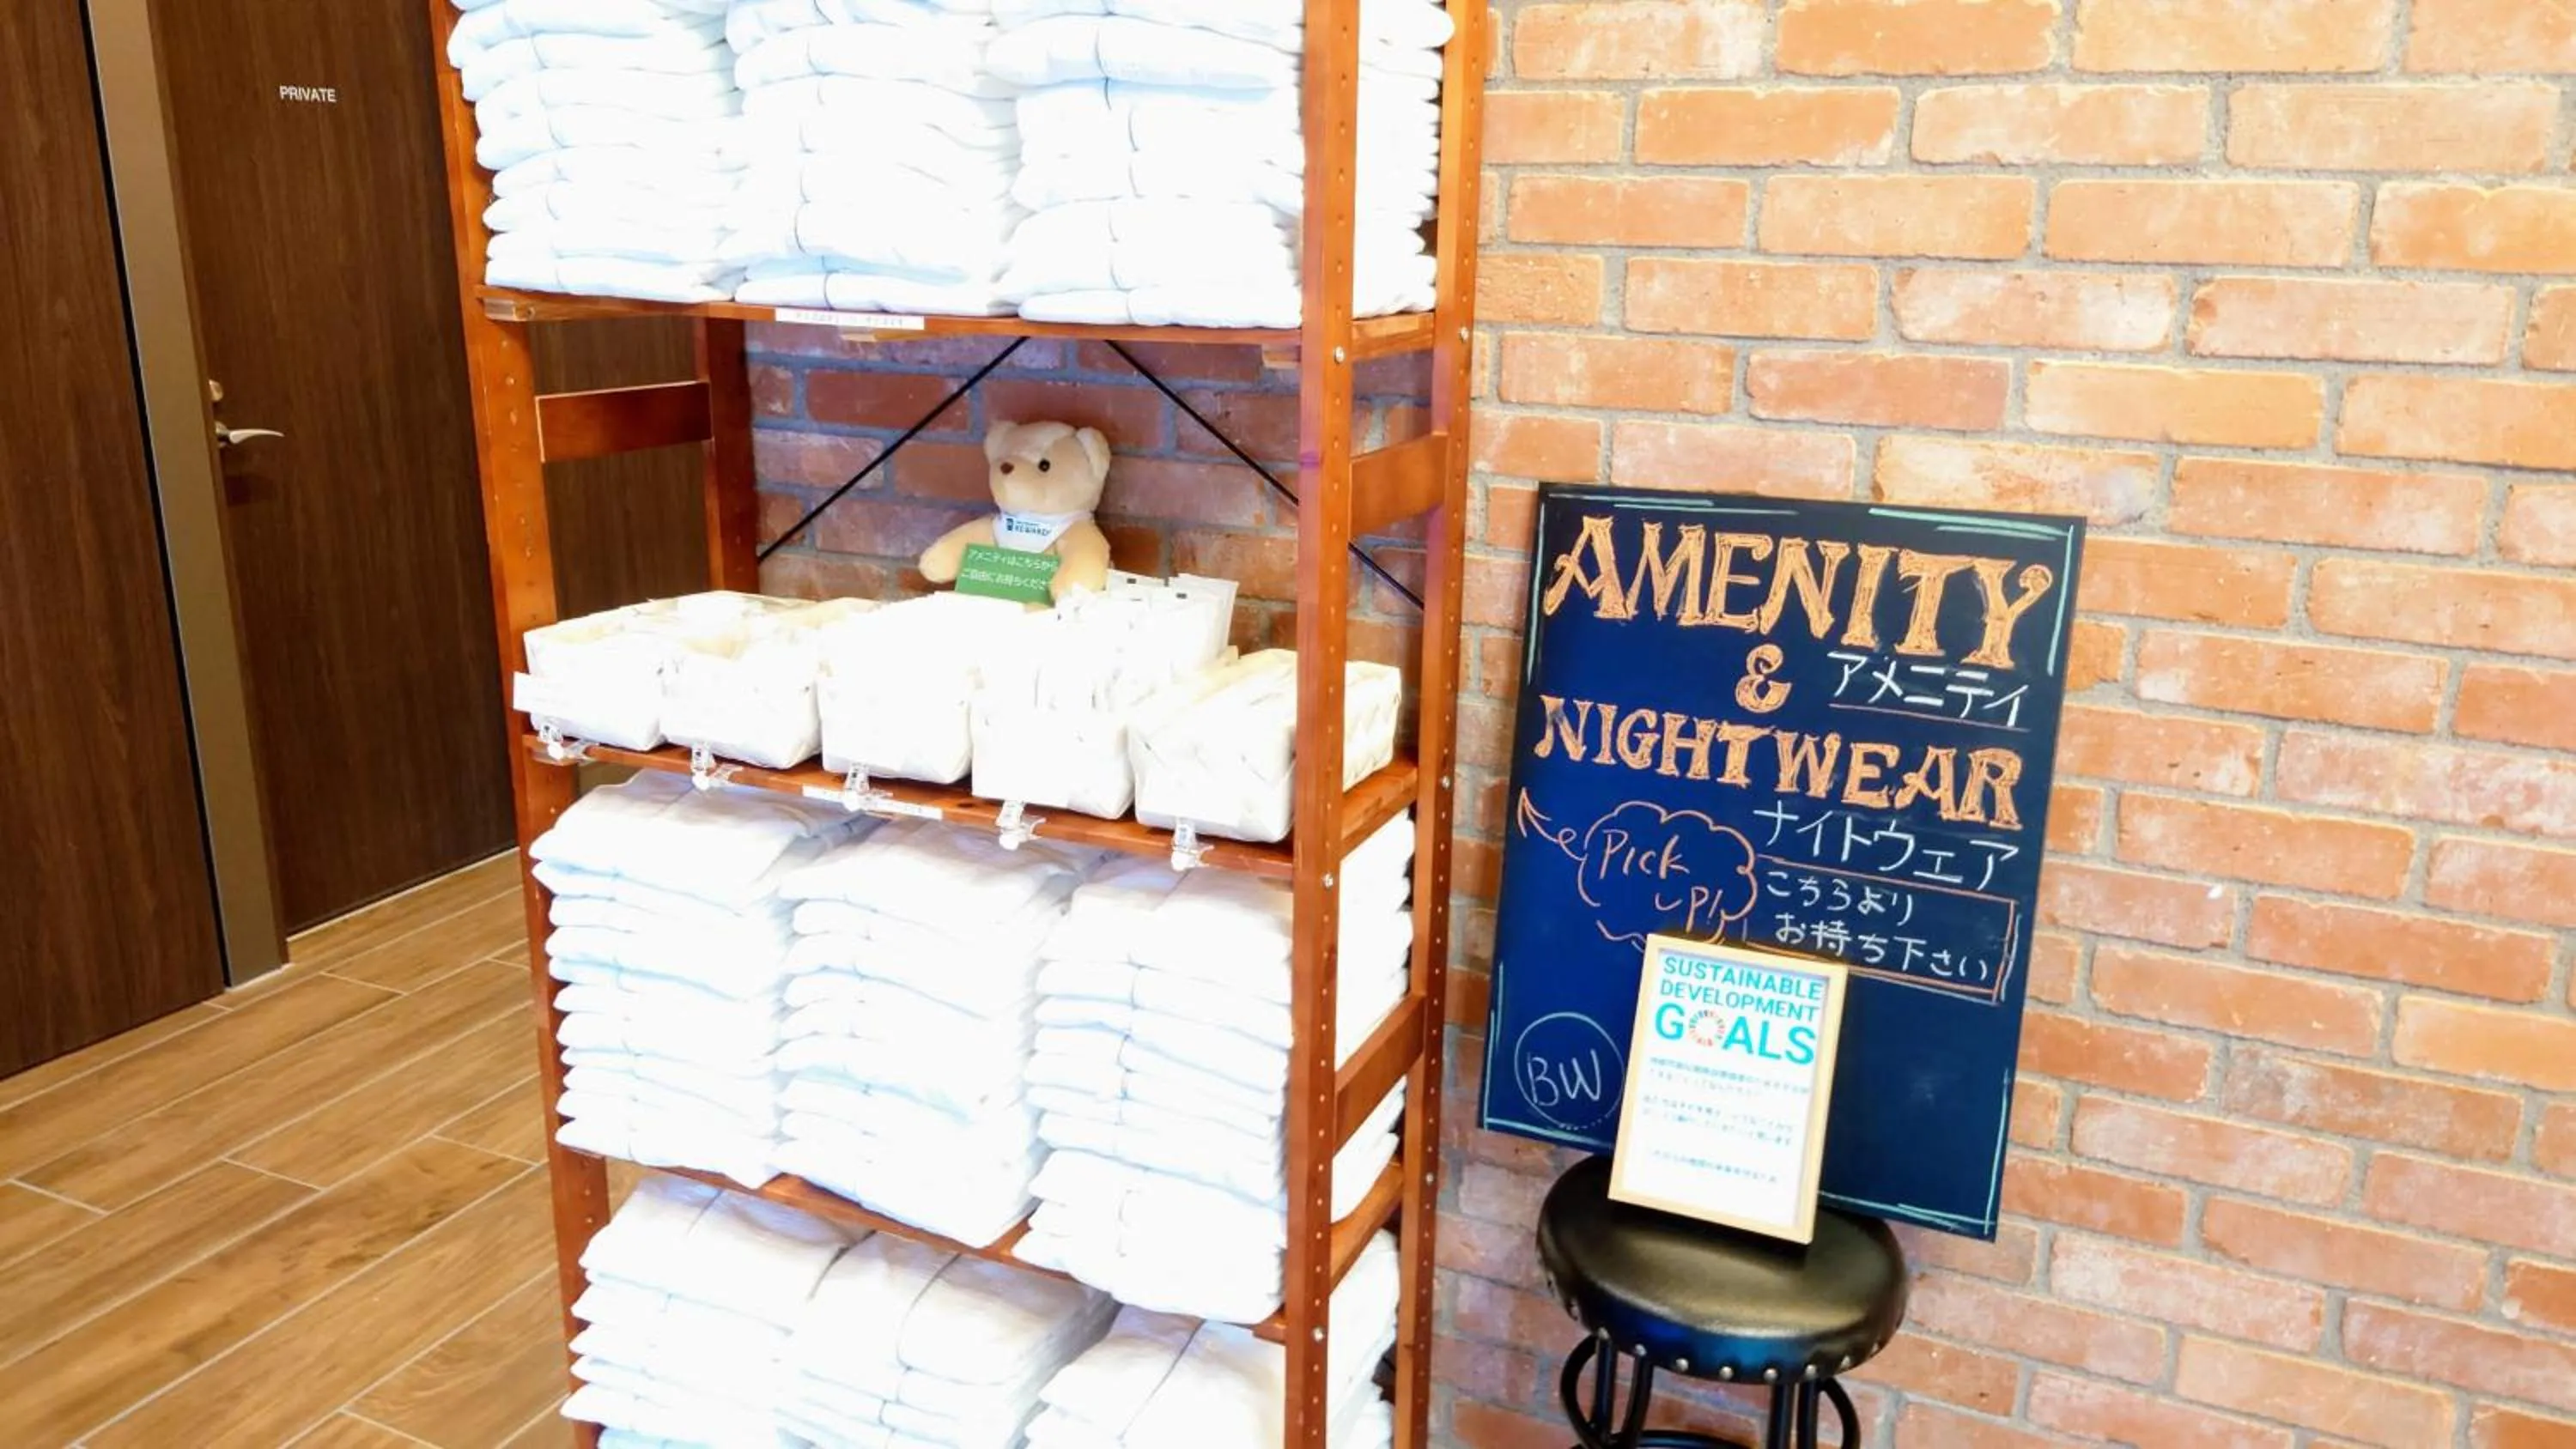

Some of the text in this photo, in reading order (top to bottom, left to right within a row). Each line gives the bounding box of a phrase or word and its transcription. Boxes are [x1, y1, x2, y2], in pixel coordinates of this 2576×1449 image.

[279, 85, 337, 102] PRIVATE
[960, 567, 1049, 591] ご自由にお持ちくださ
[1545, 516, 2052, 669] AMENITY
[1735, 644, 1792, 713] &
[1826, 650, 2028, 727] アメニティ
[1753, 799, 2020, 892] ナイトウェア
[1765, 870, 1914, 927] こちらより
[1774, 912, 1989, 982] お持ち下さい
[1659, 979, 1820, 1022] DEVELOPMENT
[1663, 955, 1824, 1002] SUSTAINABLE
[1654, 1002, 1818, 1065] GOALS
[1527, 1047, 1602, 1107] BW
